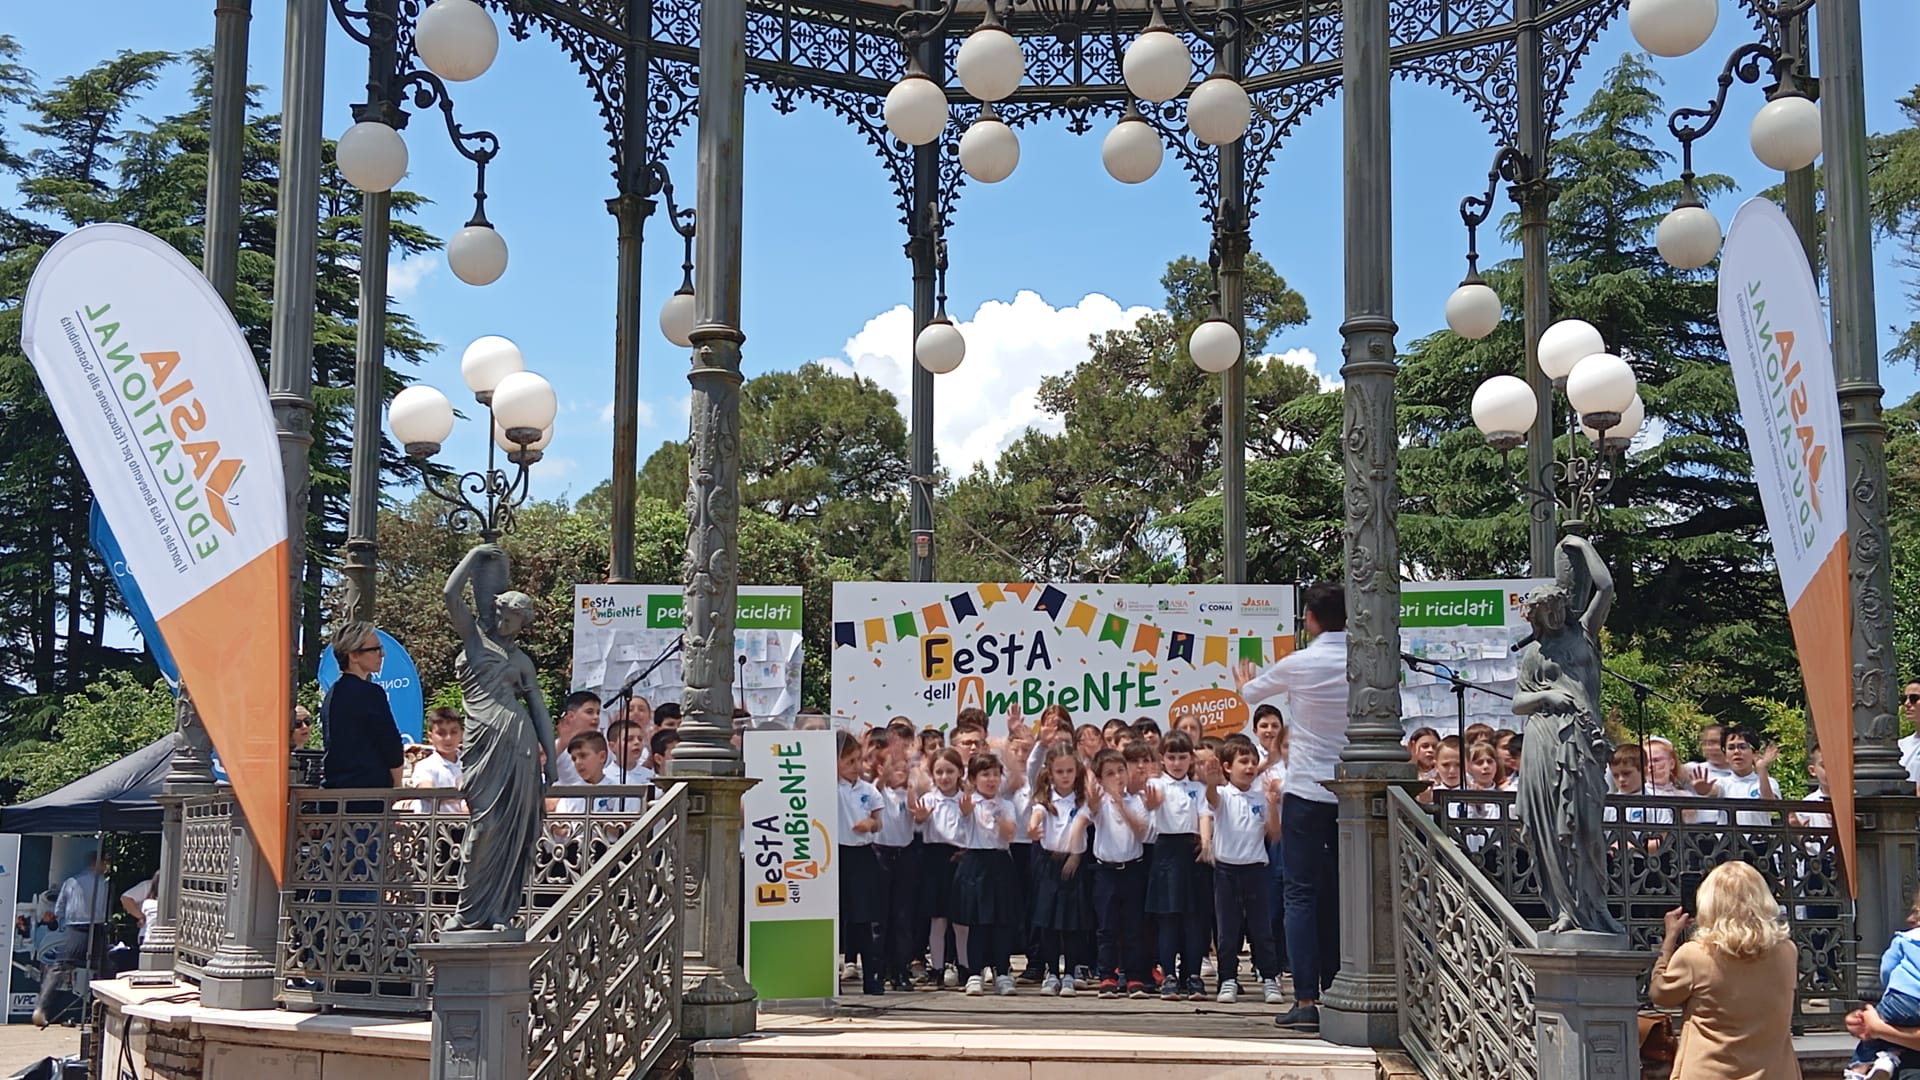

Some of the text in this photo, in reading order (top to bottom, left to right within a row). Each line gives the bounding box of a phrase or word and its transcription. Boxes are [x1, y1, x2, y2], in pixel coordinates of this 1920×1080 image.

[735, 602, 792, 621] iciclati
[1425, 598, 1494, 617] riciclati
[1175, 697, 1238, 718] 29 MAGGIO
[1199, 711, 1224, 726] 024
[13, 994, 37, 1005] IVPC
